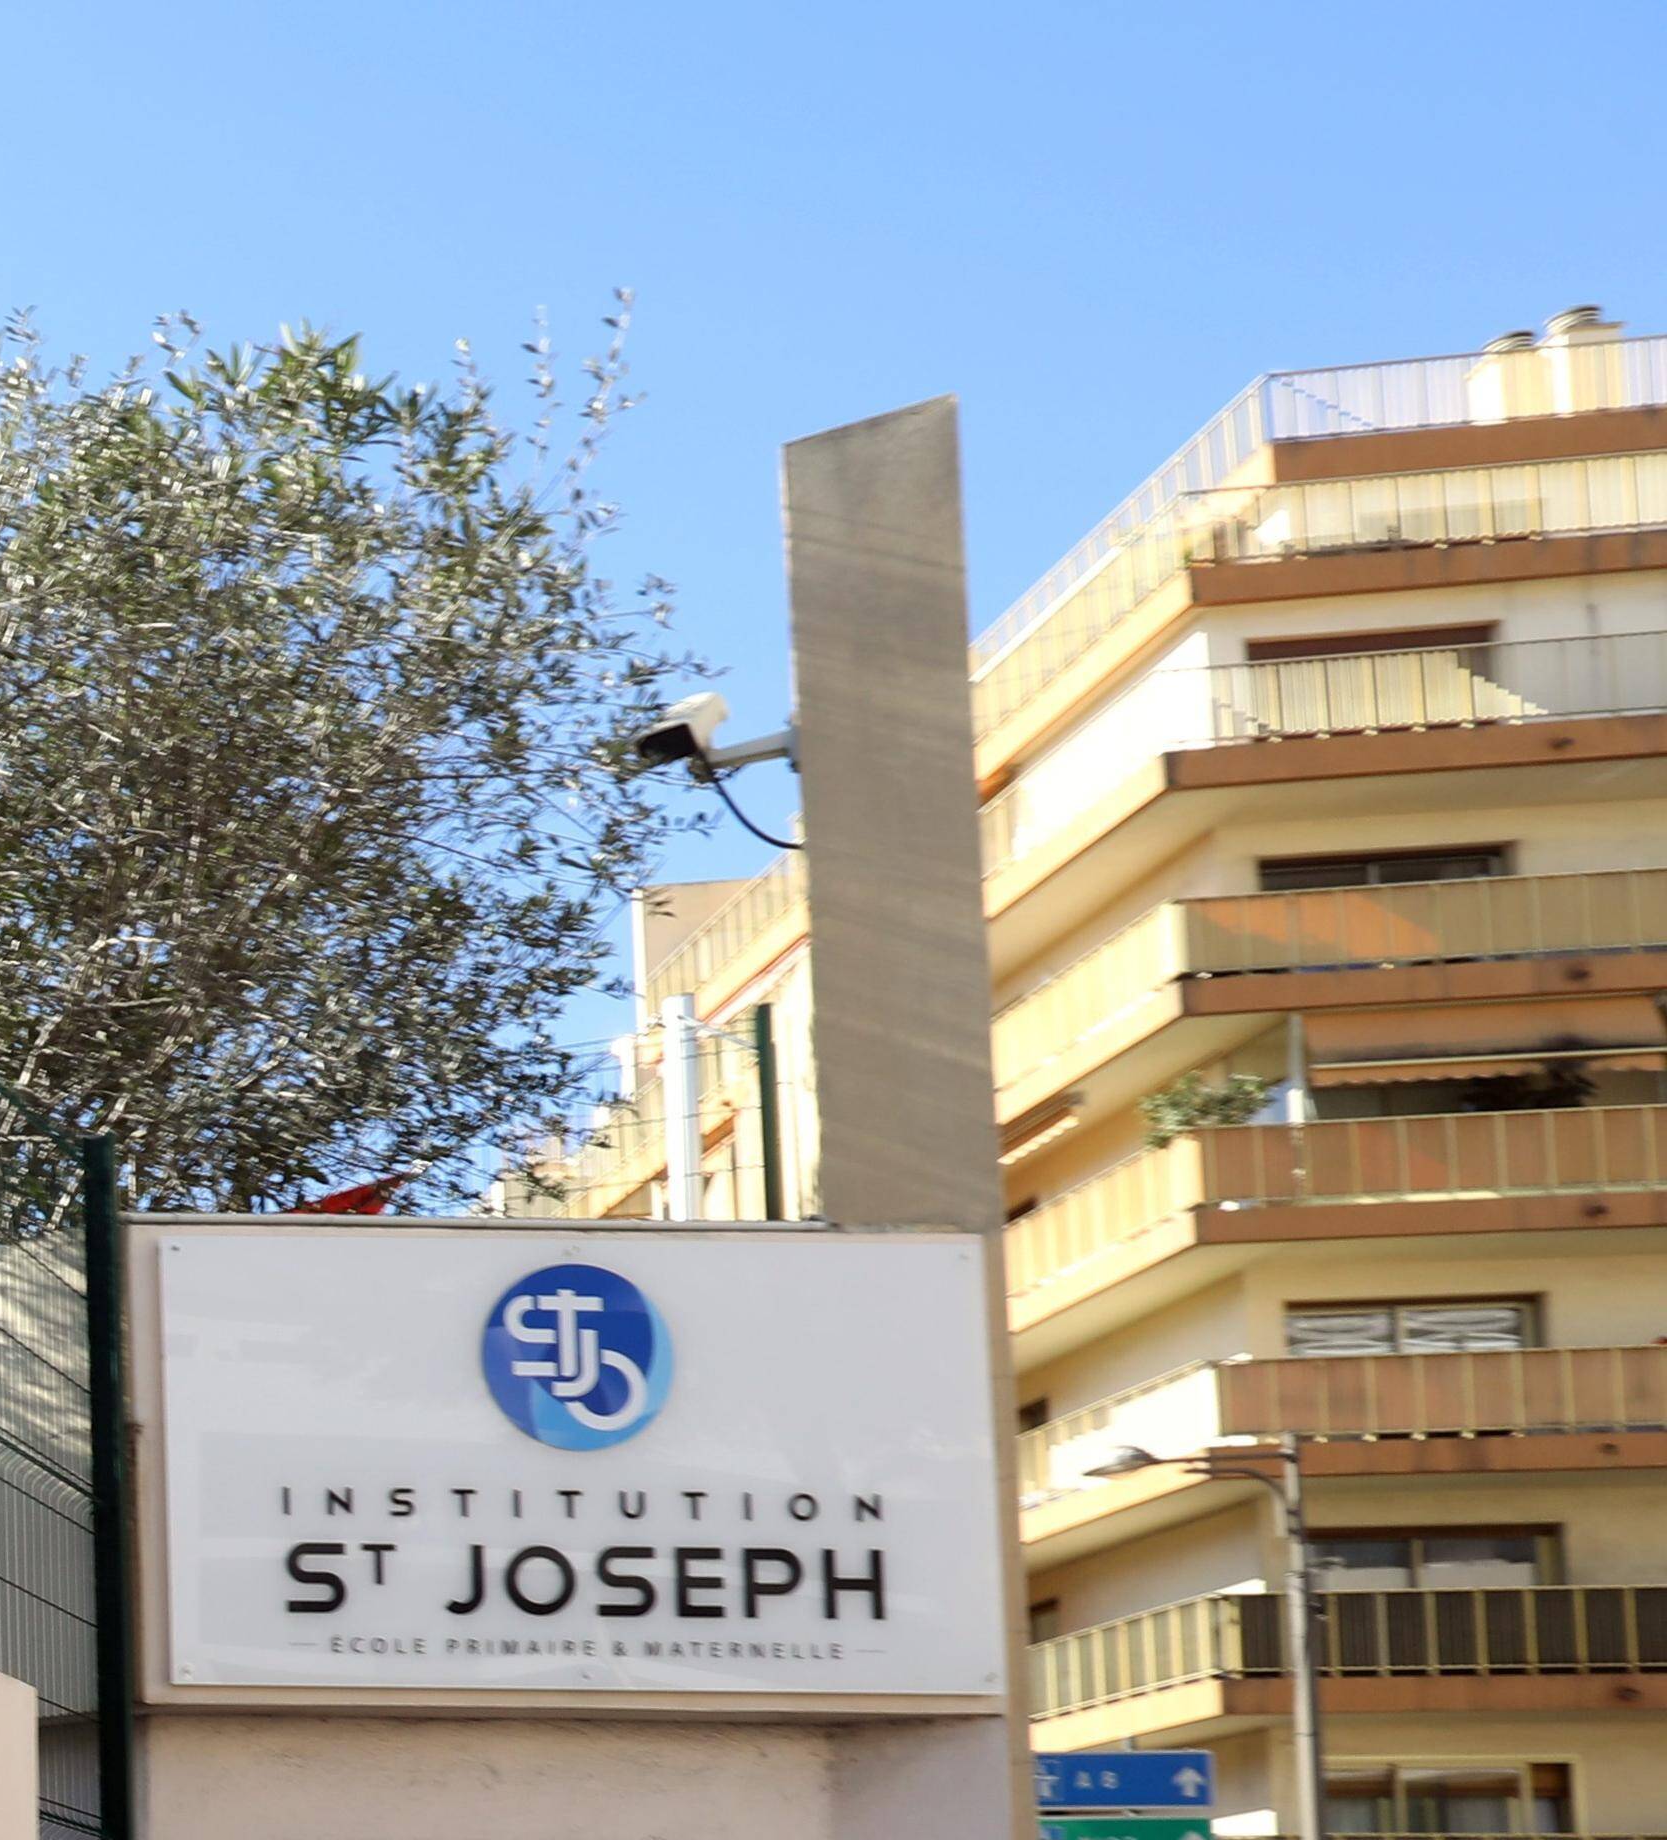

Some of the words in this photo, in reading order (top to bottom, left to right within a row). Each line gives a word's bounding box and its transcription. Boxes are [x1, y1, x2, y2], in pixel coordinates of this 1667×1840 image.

[282, 1487, 884, 1521] INSTITUTION
[446, 1544, 887, 1620] JOSEPH
[447, 1638, 597, 1657] PRIMAIRE
[612, 1640, 629, 1658] &
[644, 1640, 845, 1660] MATERNELLE
